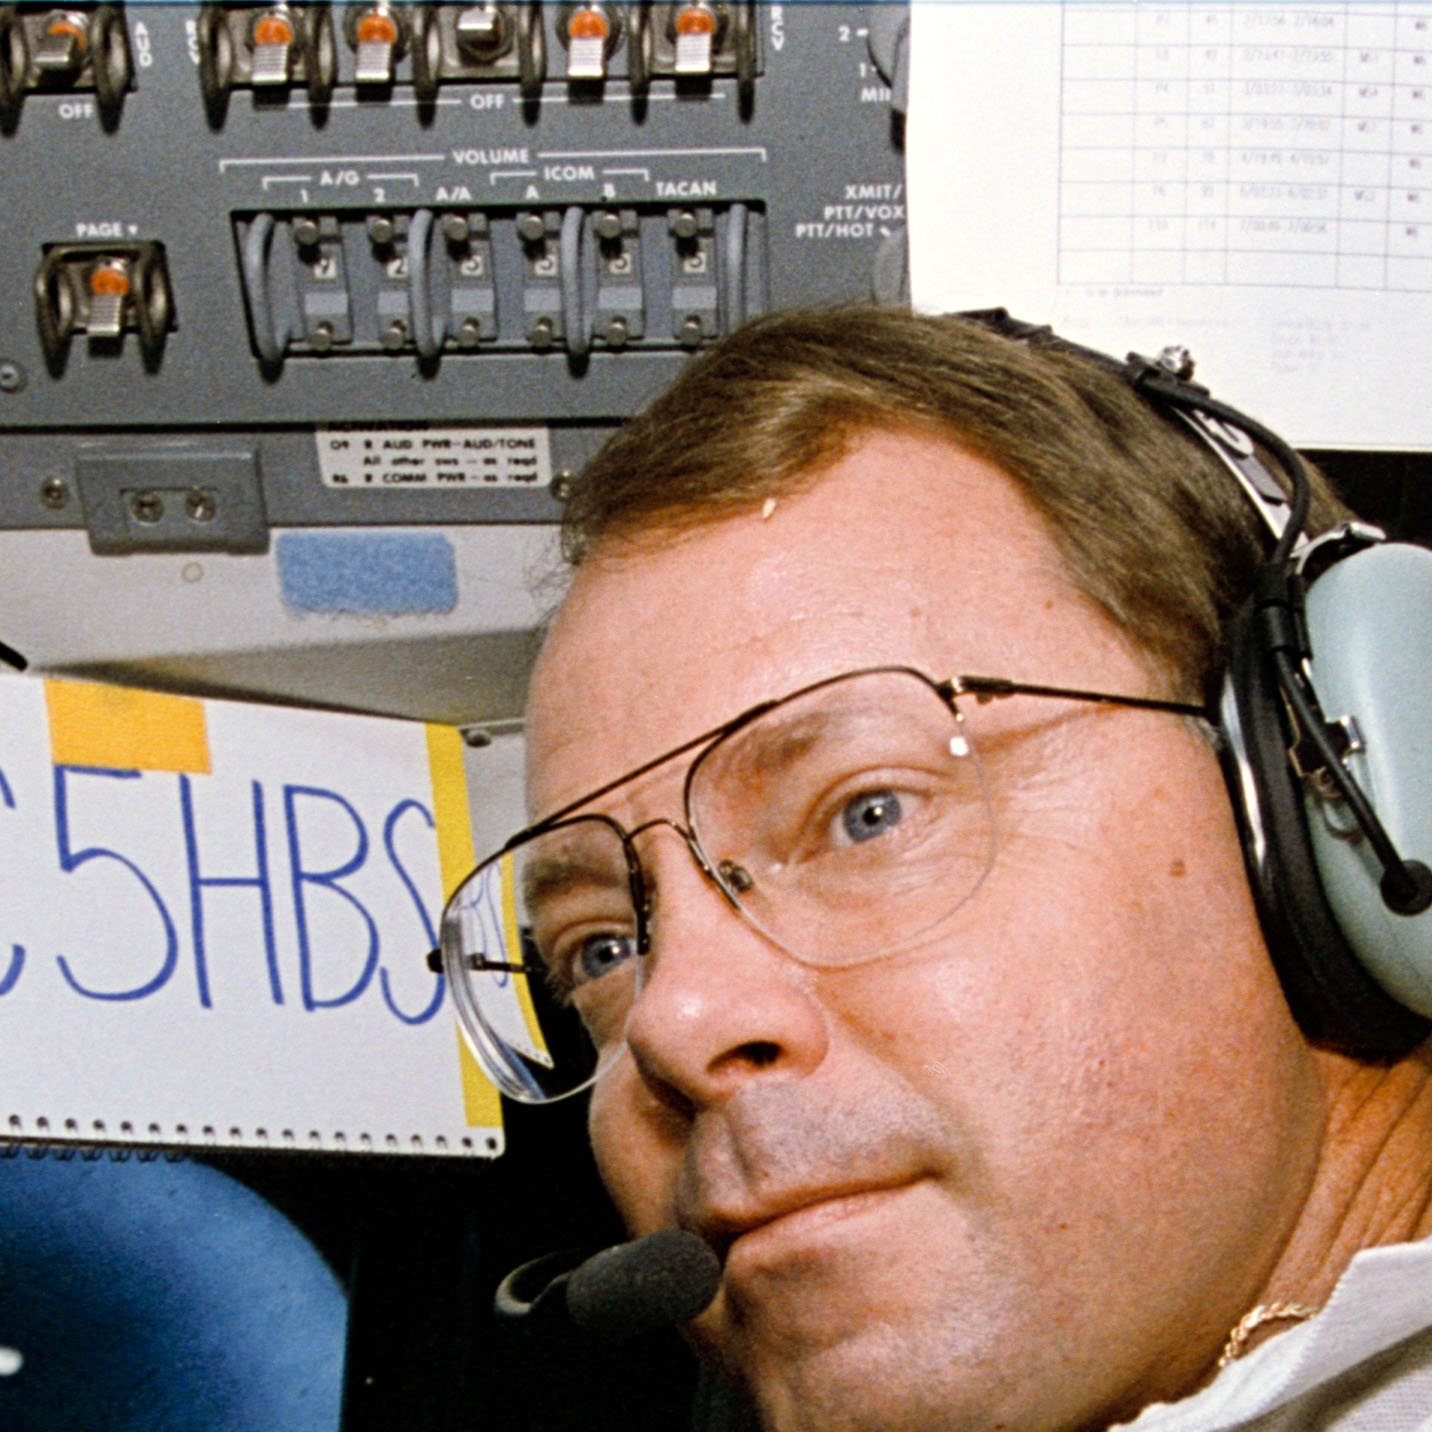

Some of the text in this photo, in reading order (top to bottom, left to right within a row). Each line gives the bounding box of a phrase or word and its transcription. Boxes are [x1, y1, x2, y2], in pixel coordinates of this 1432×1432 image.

[838, 25, 850, 42] 2
[134, 21, 152, 68] AUD
[470, 94, 505, 109] OFF
[58, 104, 93, 120] OFF
[452, 150, 530, 165] VOLUME
[320, 171, 360, 187] A/G
[544, 166, 595, 180] ICOM
[373, 188, 386, 202] 2
[435, 186, 473, 201] A/A
[525, 185, 540, 199] A
[603, 184, 616, 198] B
[656, 181, 717, 197] TACAN
[824, 205, 904, 220] PTT/VOX
[75, 222, 123, 238] PAGE
[795, 223, 873, 238] PTT/HOT
[383, 440, 413, 449] AUD
[383, 474, 427, 483] COMM
[437, 473, 466, 482] PWR
